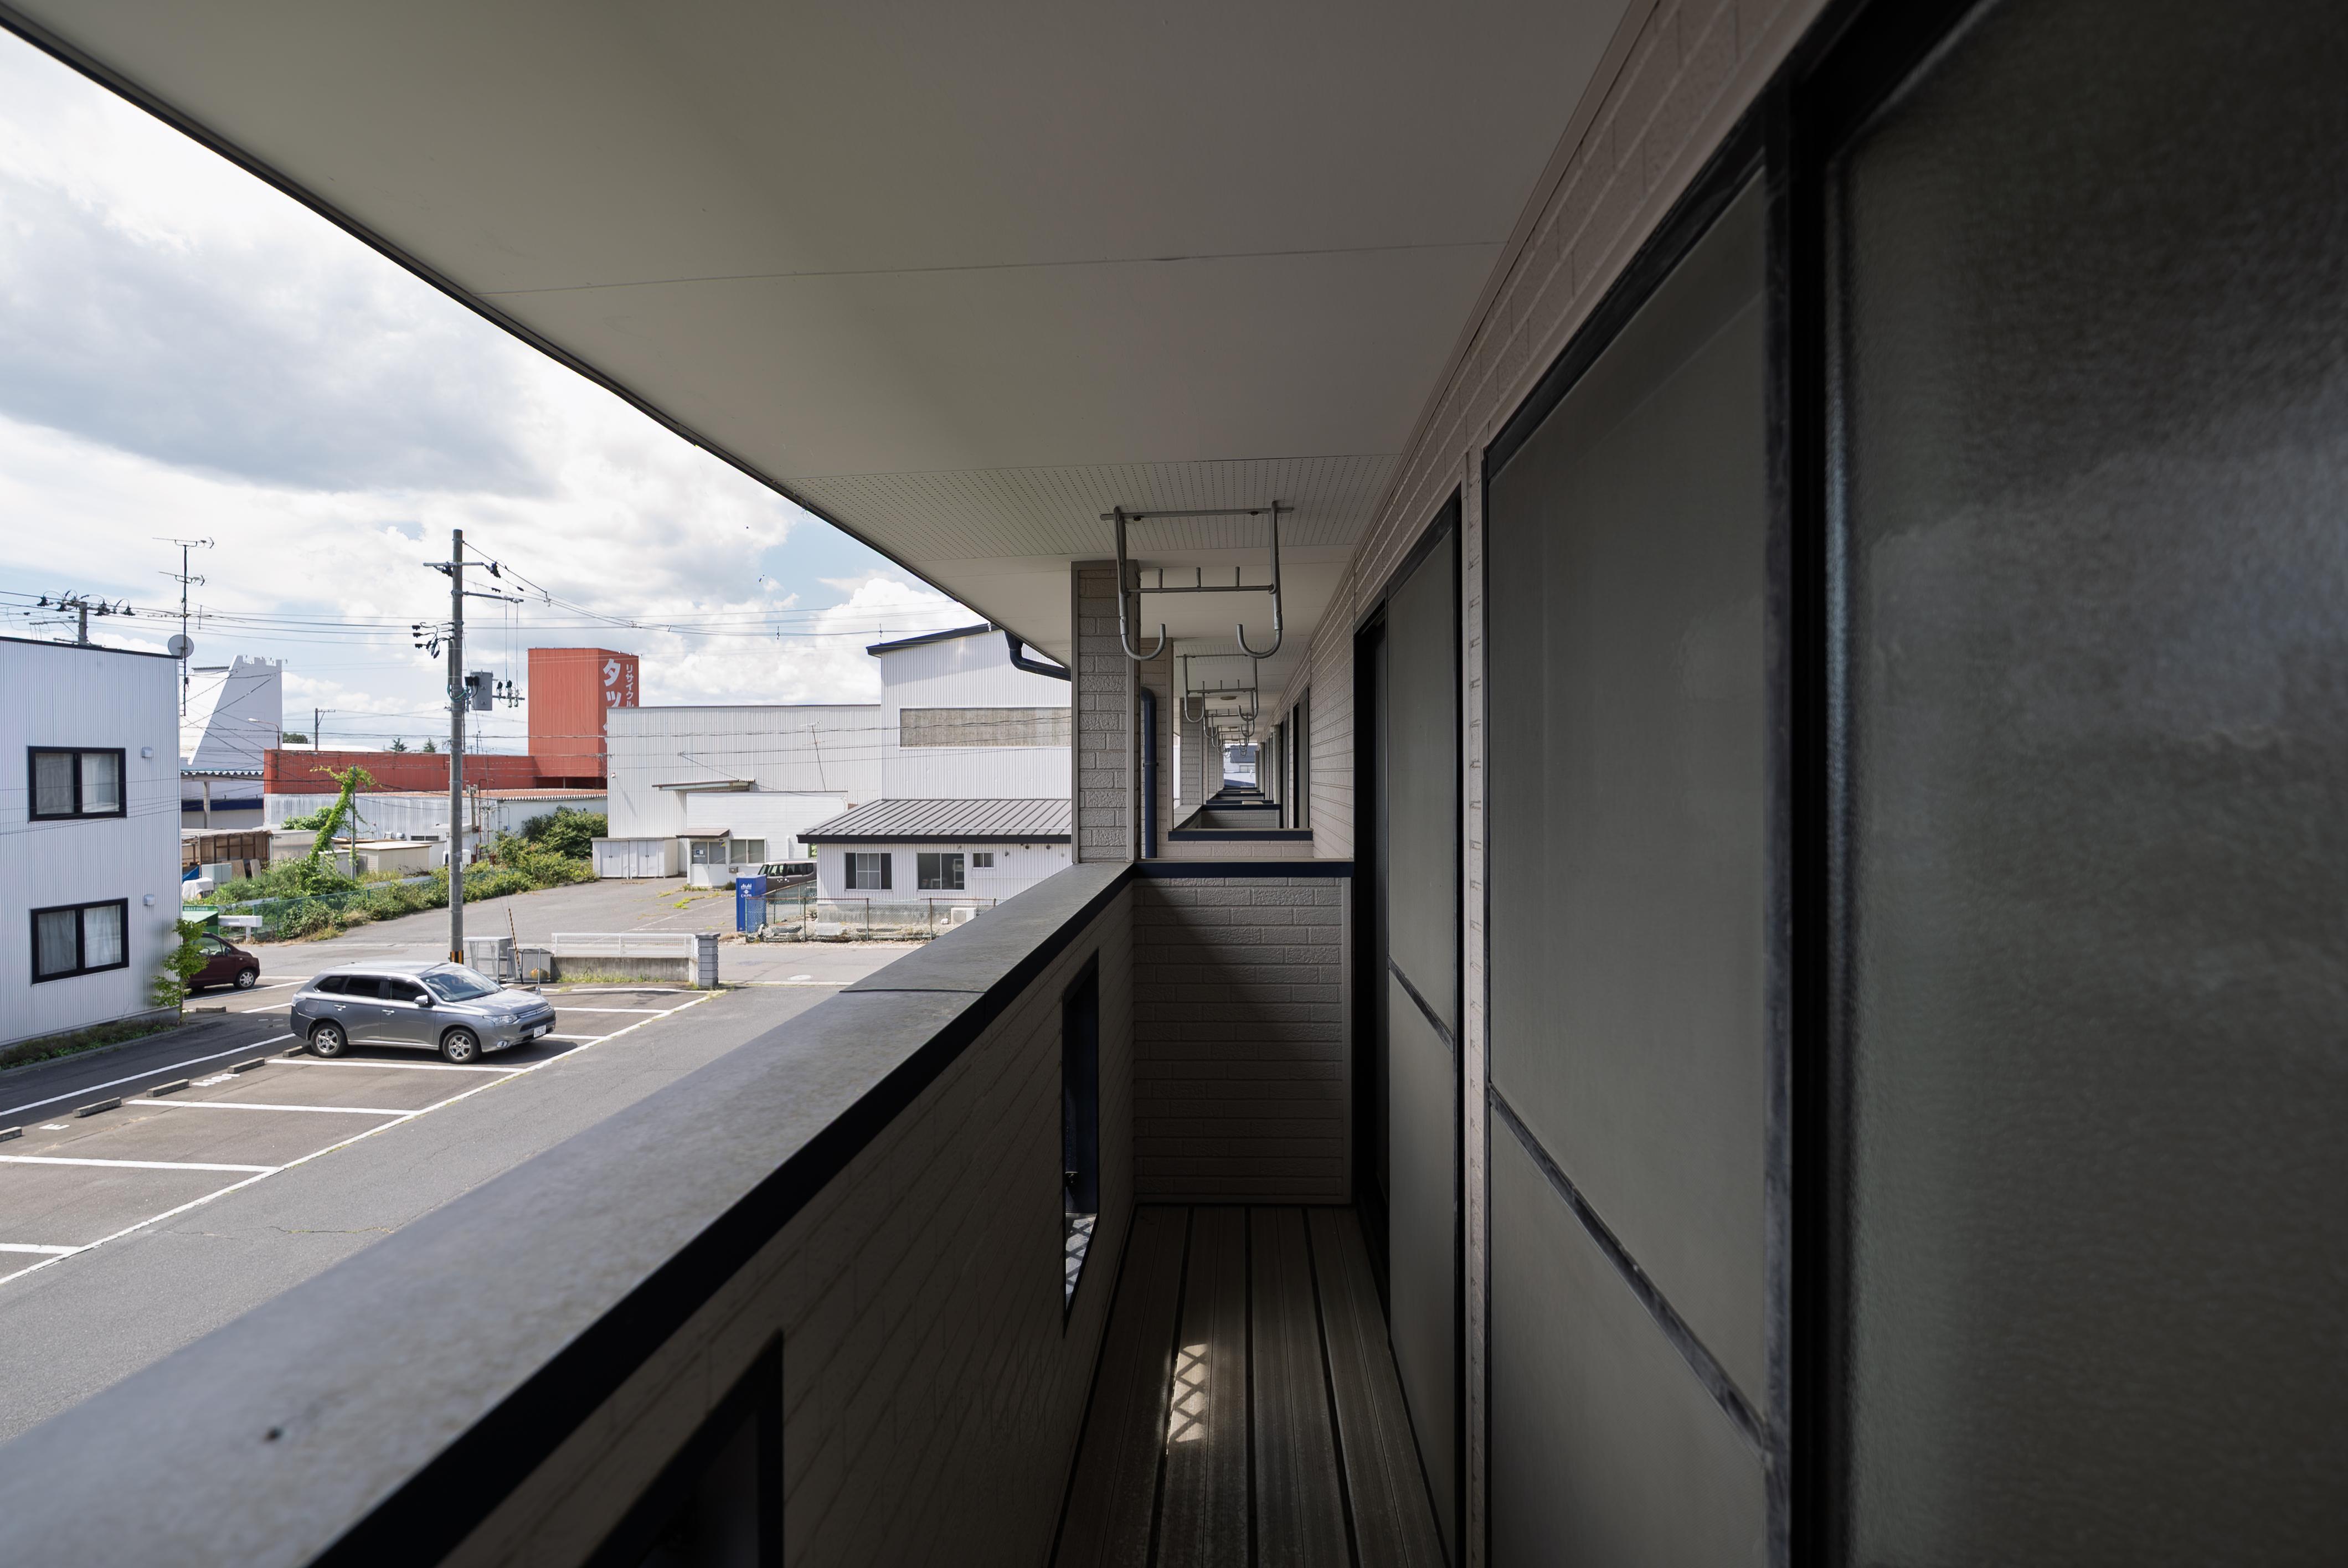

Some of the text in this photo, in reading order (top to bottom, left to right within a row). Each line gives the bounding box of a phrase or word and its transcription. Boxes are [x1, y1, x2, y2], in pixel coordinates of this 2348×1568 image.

[625, 664, 634, 707] リサイクル
